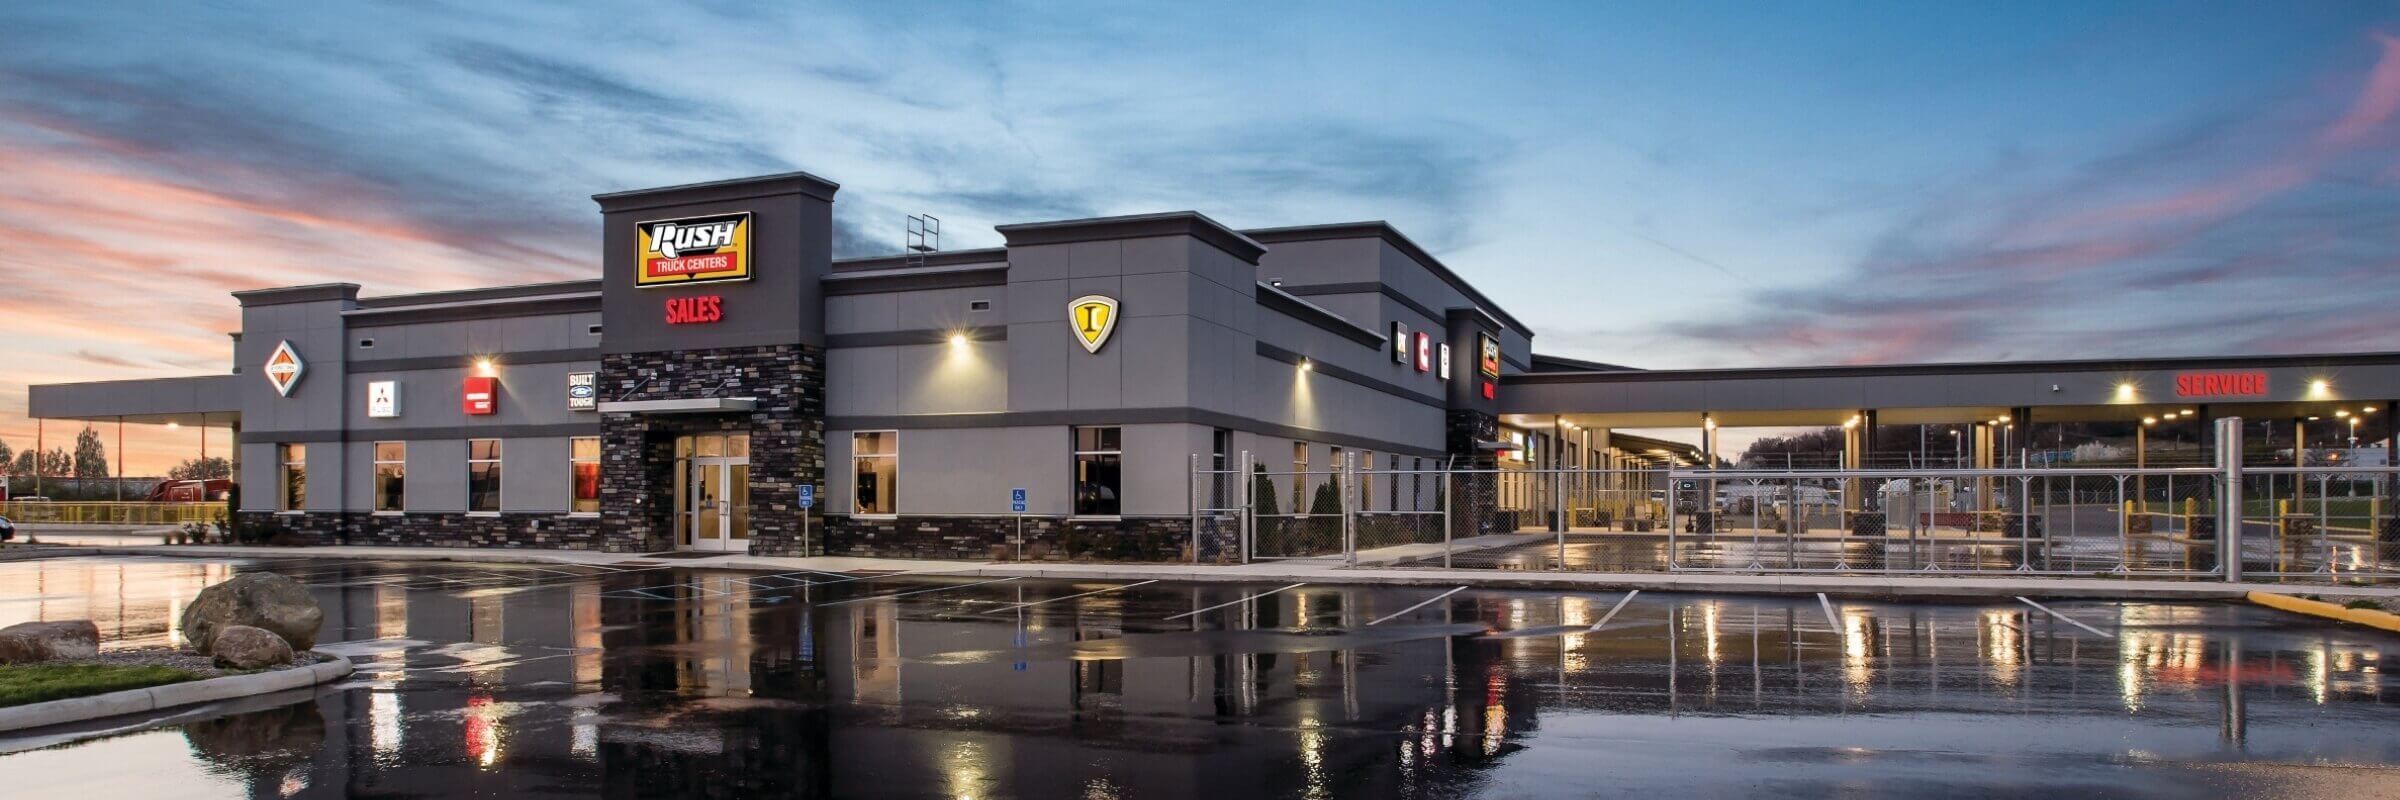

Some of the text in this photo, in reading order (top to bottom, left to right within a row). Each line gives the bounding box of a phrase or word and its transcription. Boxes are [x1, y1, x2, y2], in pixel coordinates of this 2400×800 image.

[656, 256, 727, 273] TRUCK CENTERS
[665, 296, 721, 324] SALES
[570, 374, 593, 386] BUILT
[2176, 374, 2265, 396] SERVICE
